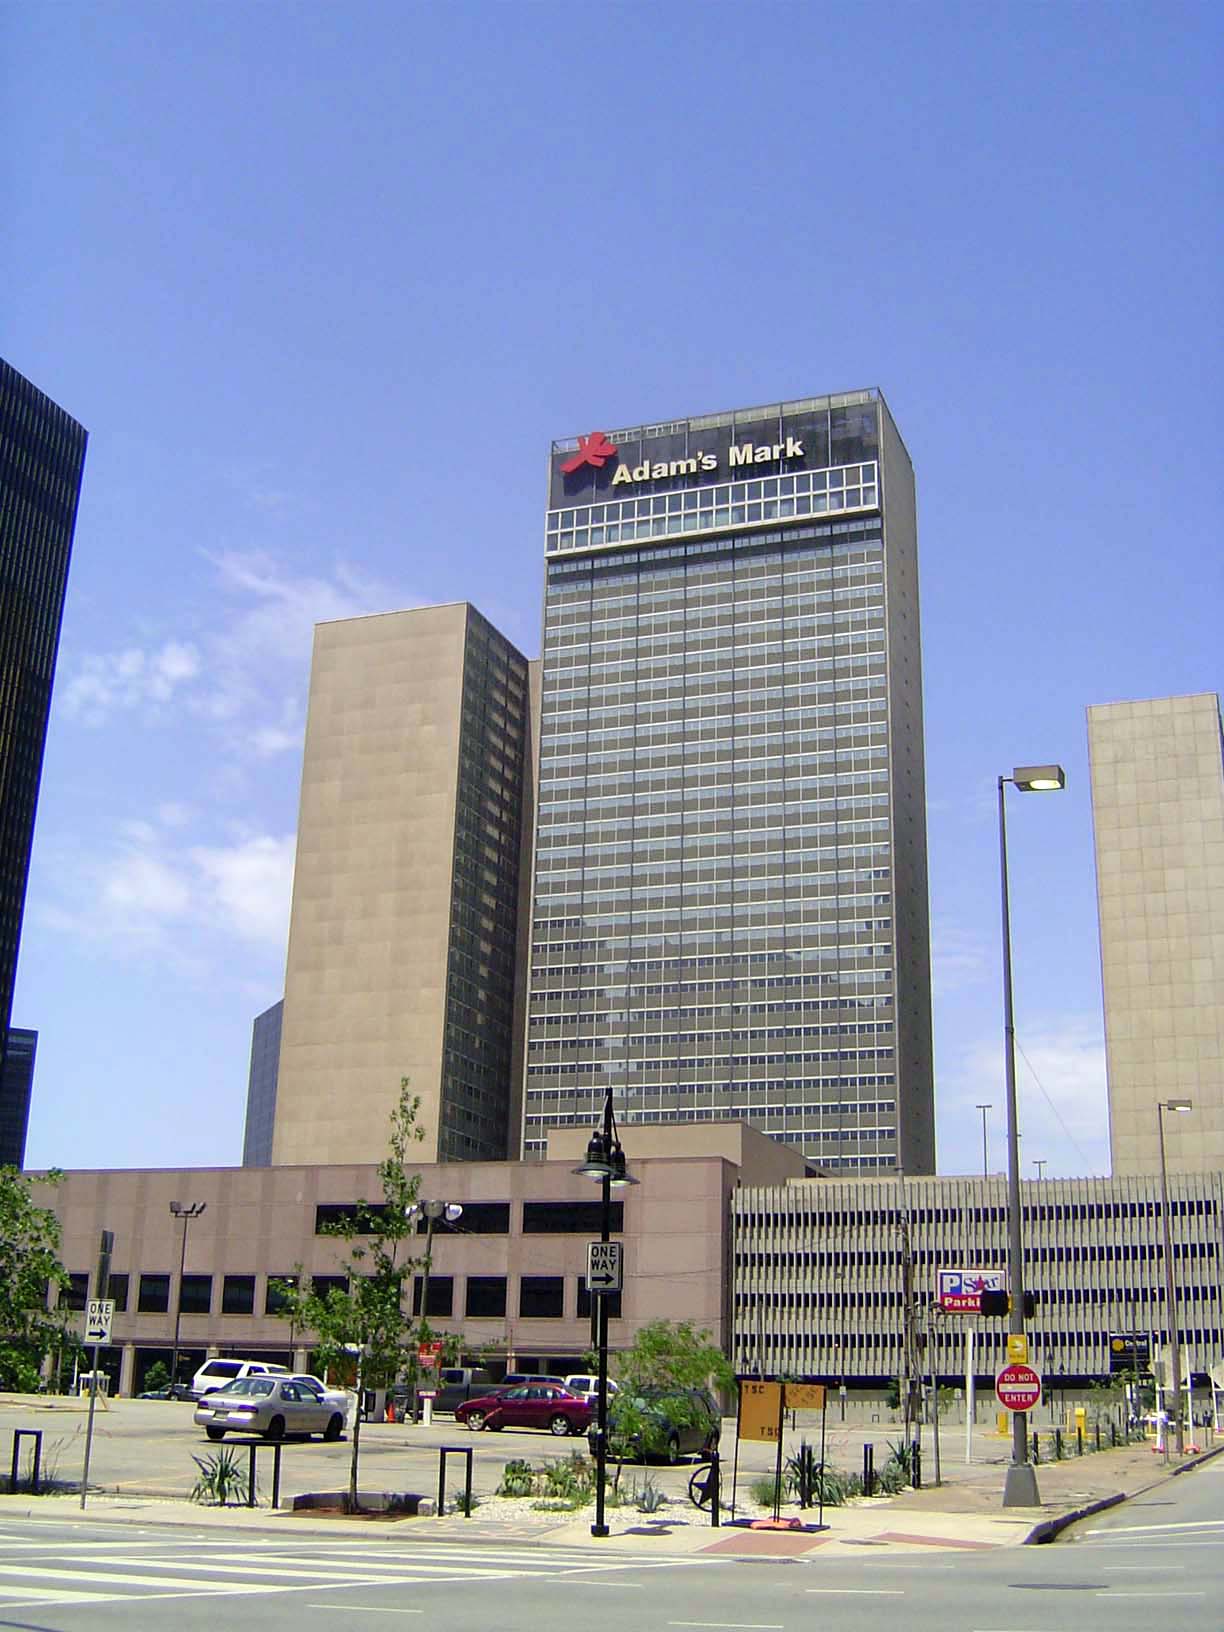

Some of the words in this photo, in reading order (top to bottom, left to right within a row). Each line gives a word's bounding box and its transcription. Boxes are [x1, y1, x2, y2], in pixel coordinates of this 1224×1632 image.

[611, 450, 717, 486] Adam's
[728, 436, 804, 467] Mark
[591, 1246, 617, 1257] ONE
[591, 1259, 617, 1270] WAY
[942, 1274, 961, 1294] P
[943, 1297, 980, 1307] Parki
[90, 1303, 111, 1313] ONE
[89, 1316, 111, 1326] WAY
[1004, 1373, 1015, 1382] DO
[1018, 1373, 1034, 1382] NOT
[1004, 1393, 1033, 1402] ENTER
